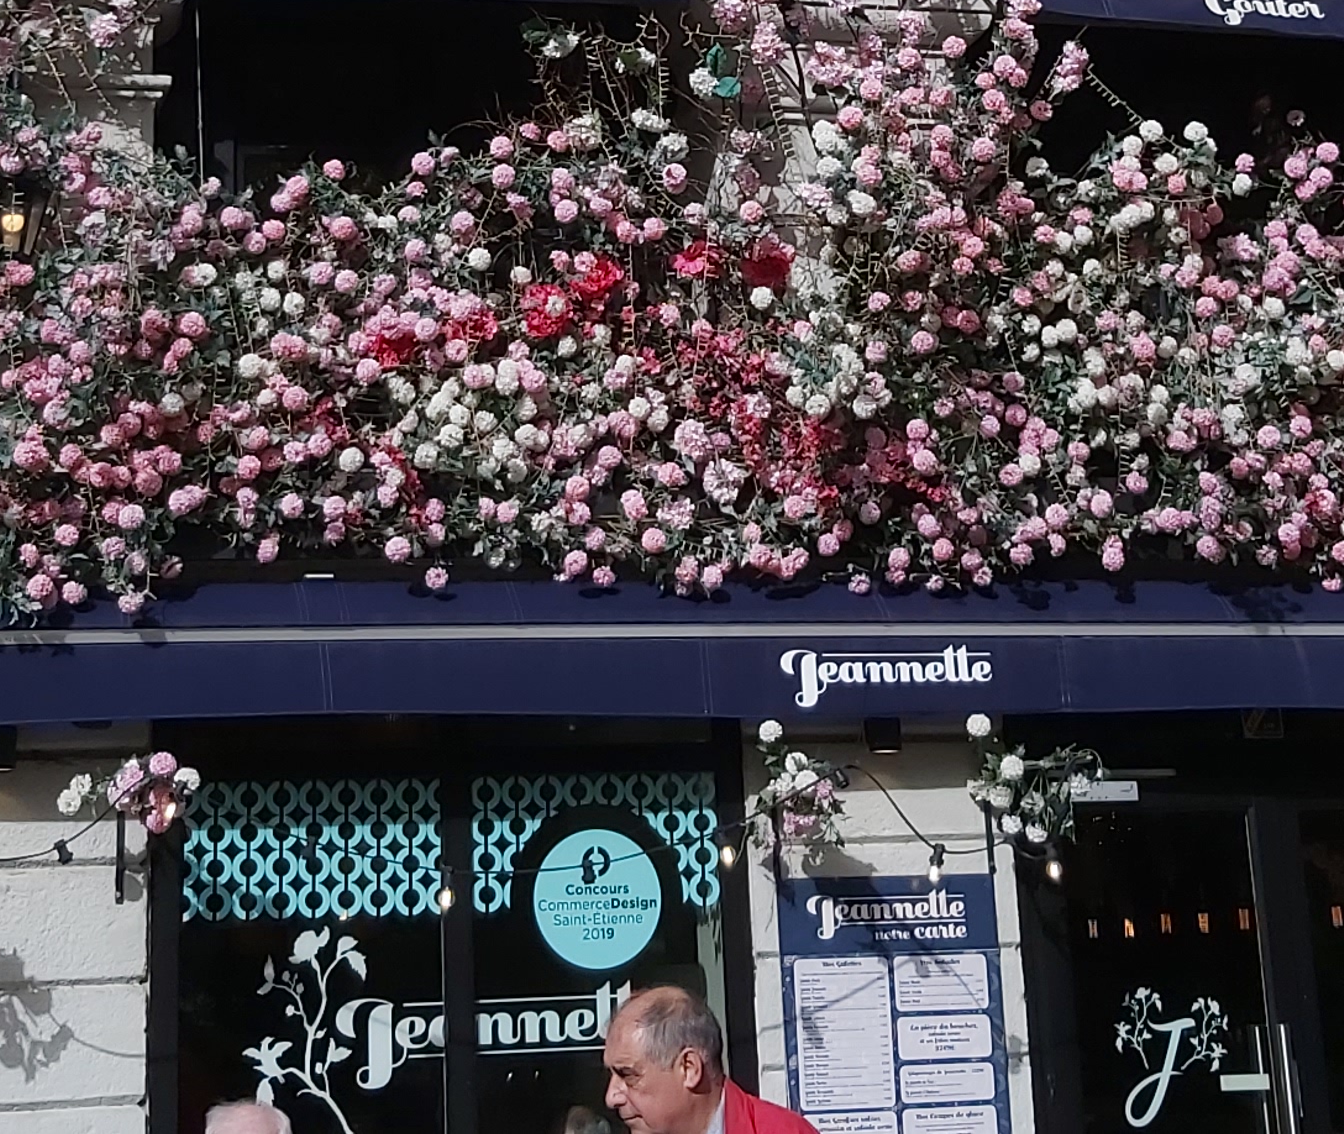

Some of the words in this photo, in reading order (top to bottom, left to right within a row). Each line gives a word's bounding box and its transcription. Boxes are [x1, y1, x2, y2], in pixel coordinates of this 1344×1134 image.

[780, 644, 992, 707] Jeannette
[537, 896, 657, 912] CommerceDesign
[565, 884, 630, 896] Concours
[806, 888, 966, 940] Jeannette
[582, 927, 615, 941] 2019
[875, 929, 911, 941] notre
[914, 923, 968, 939] carte
[335, 979, 631, 1090] Jennet
[1125, 1018, 1196, 1128] J
